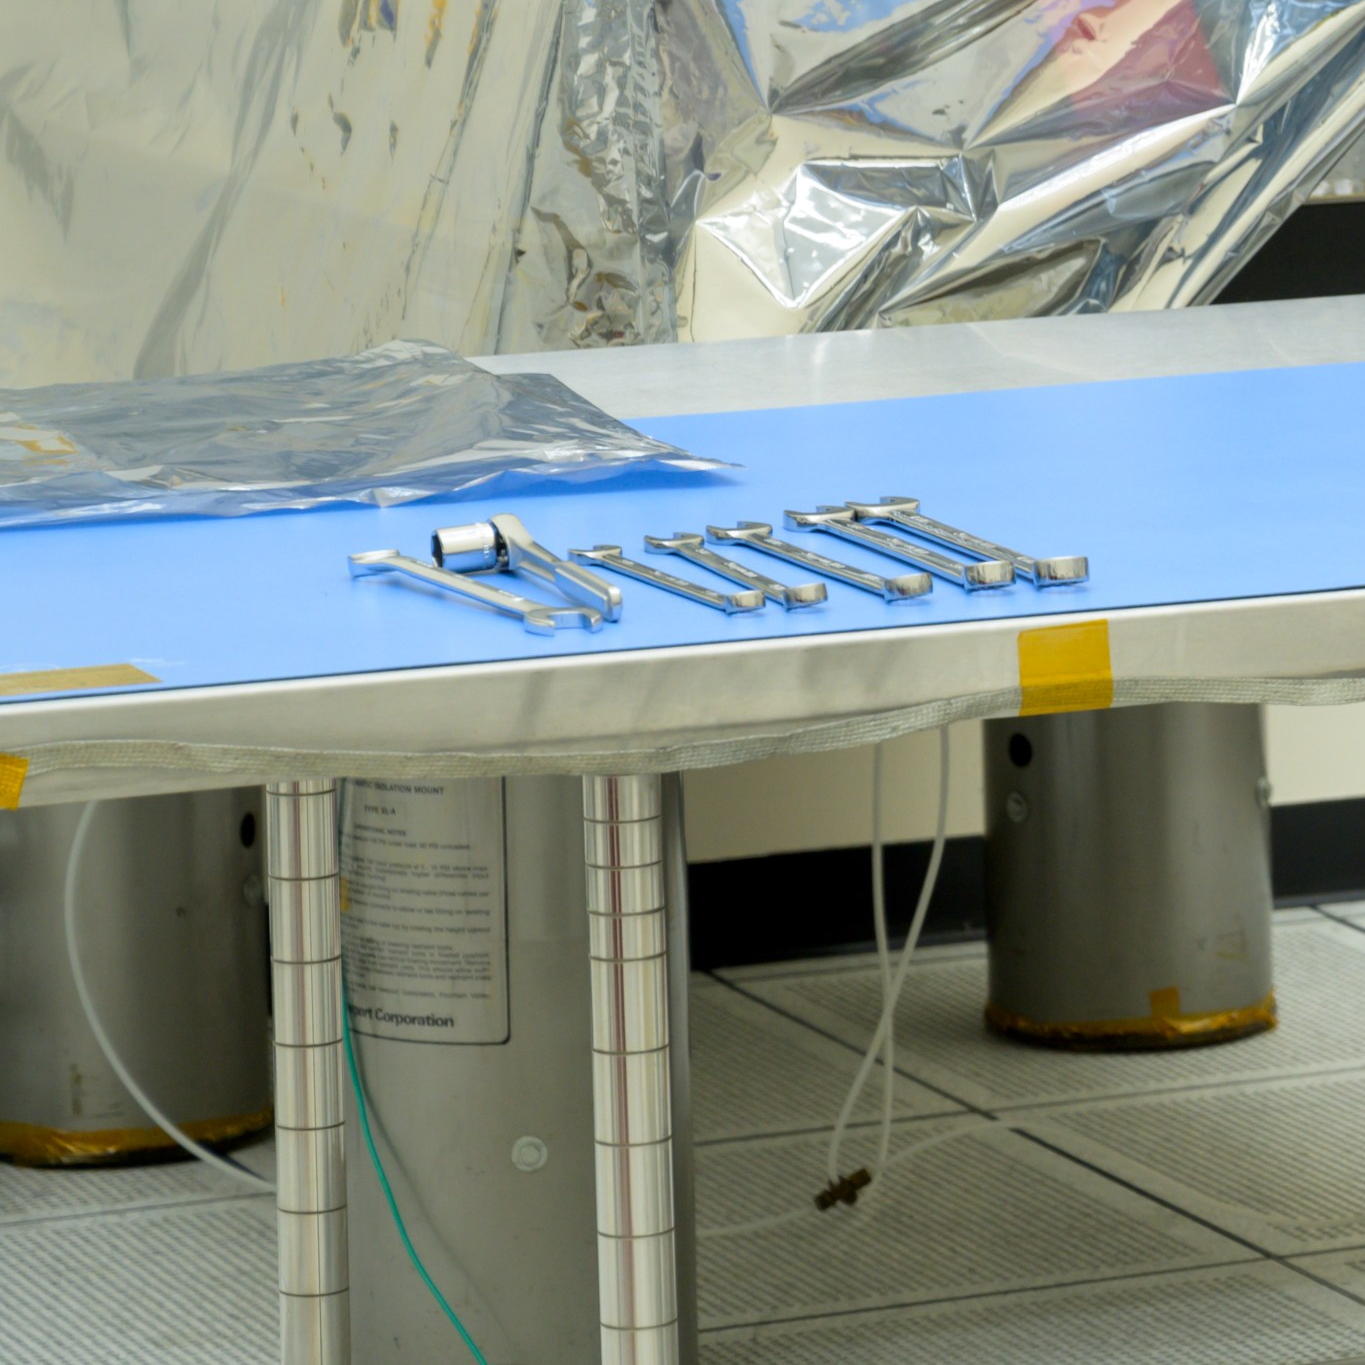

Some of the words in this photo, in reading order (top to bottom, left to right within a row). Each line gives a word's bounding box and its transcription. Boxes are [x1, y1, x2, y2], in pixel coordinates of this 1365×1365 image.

[374, 781, 412, 794] ISOLATION
[414, 786, 445, 795] MOUNT
[375, 1007, 455, 1028] Corporation
